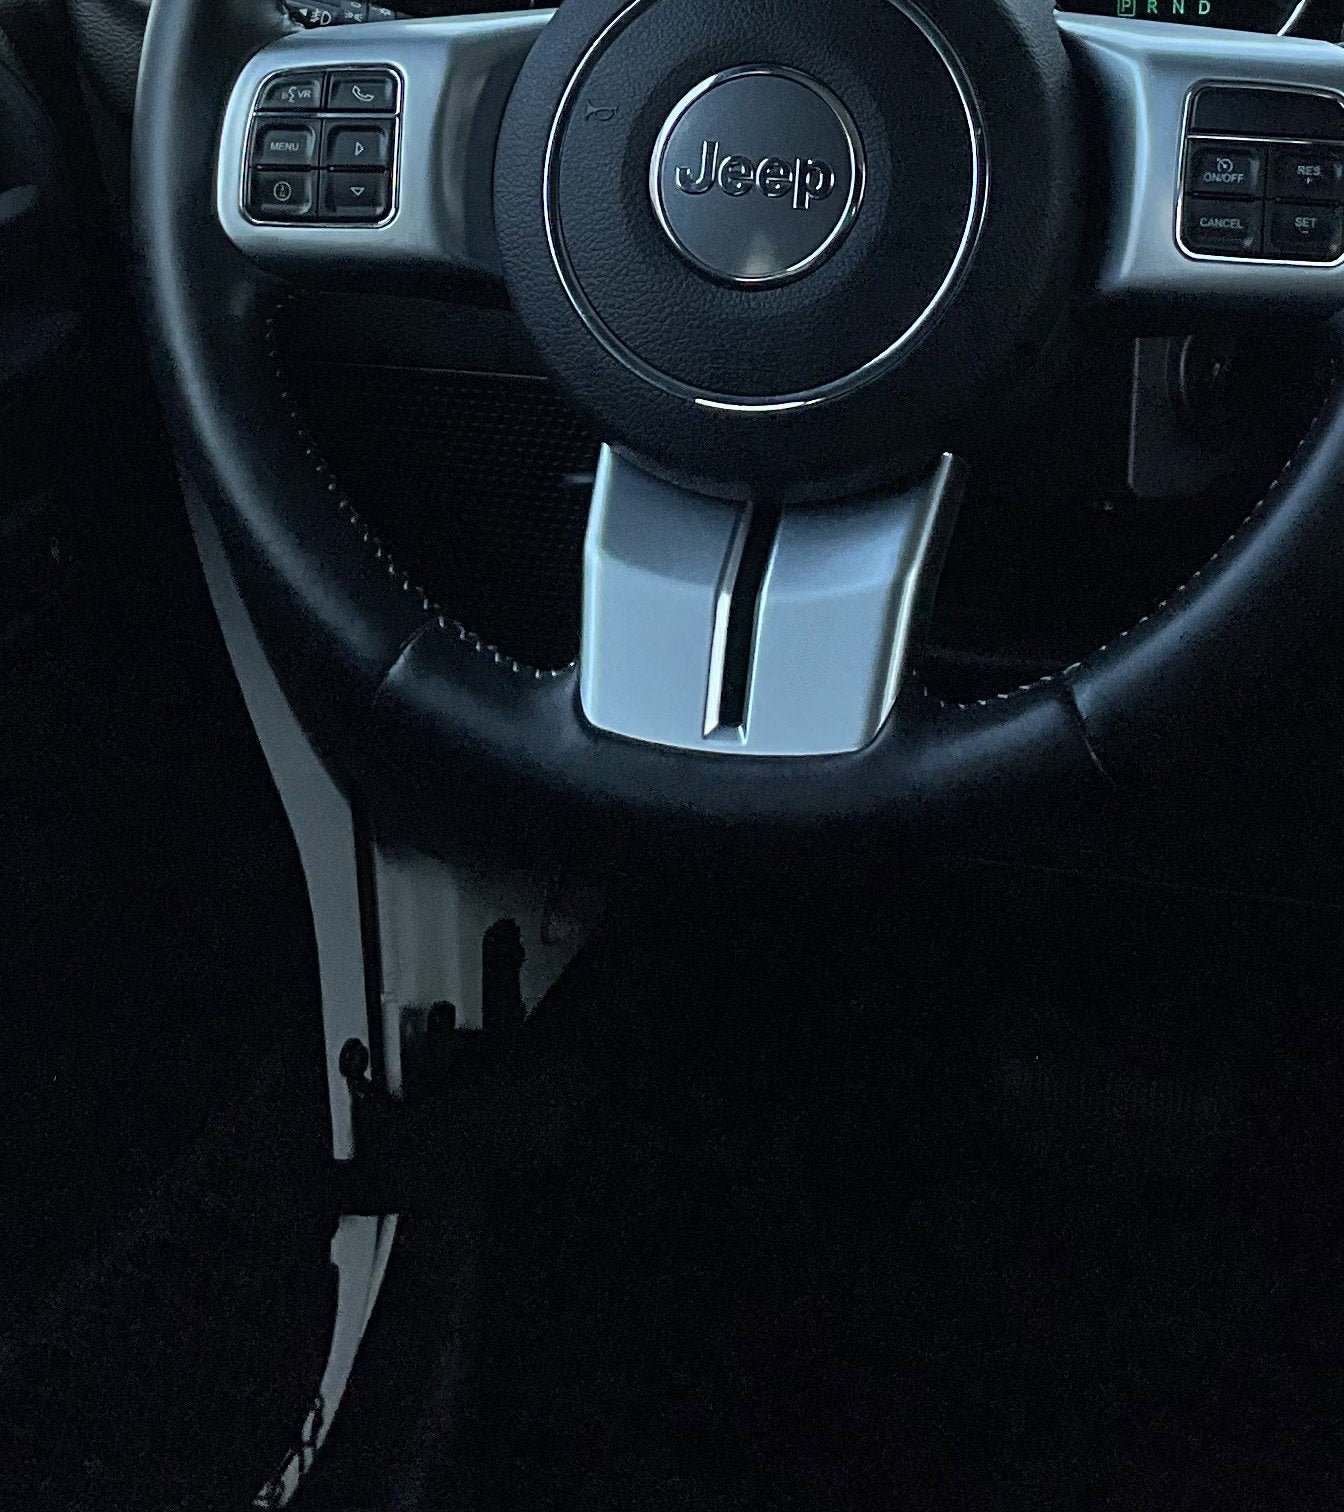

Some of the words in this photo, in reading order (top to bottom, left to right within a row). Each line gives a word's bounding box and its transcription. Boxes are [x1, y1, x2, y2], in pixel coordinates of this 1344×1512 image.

[1146, 0, 1159, 15] R
[1172, 0, 1186, 15] N
[1197, 0, 1212, 15] D
[297, 89, 312, 99] VR
[269, 141, 300, 152] MENU
[675, 140, 836, 210] Jeep
[1296, 164, 1322, 177] RES
[1202, 171, 1245, 184] ON/OFF
[1199, 216, 1244, 229] CANCEL
[1294, 216, 1318, 228] SET
